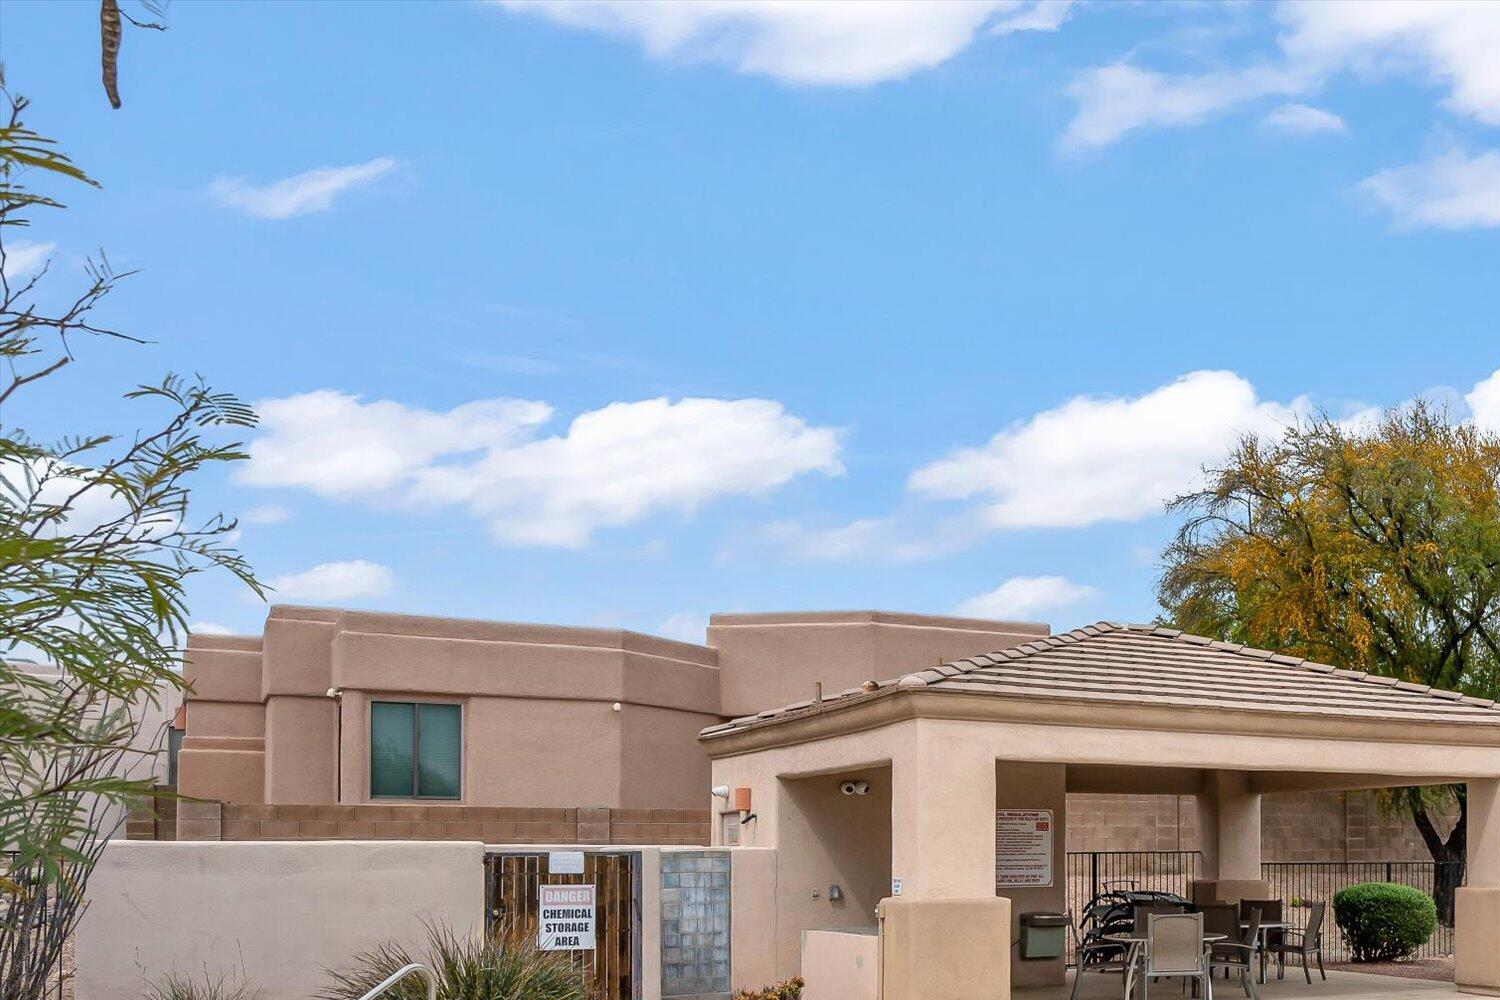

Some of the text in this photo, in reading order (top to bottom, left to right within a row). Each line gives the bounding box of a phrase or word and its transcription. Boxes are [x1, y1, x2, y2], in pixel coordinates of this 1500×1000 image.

[544, 890, 591, 903] DANGER
[543, 908, 592, 919] CHEMICAL
[545, 922, 589, 933] STORAGE
[555, 936, 580, 947] AREA
